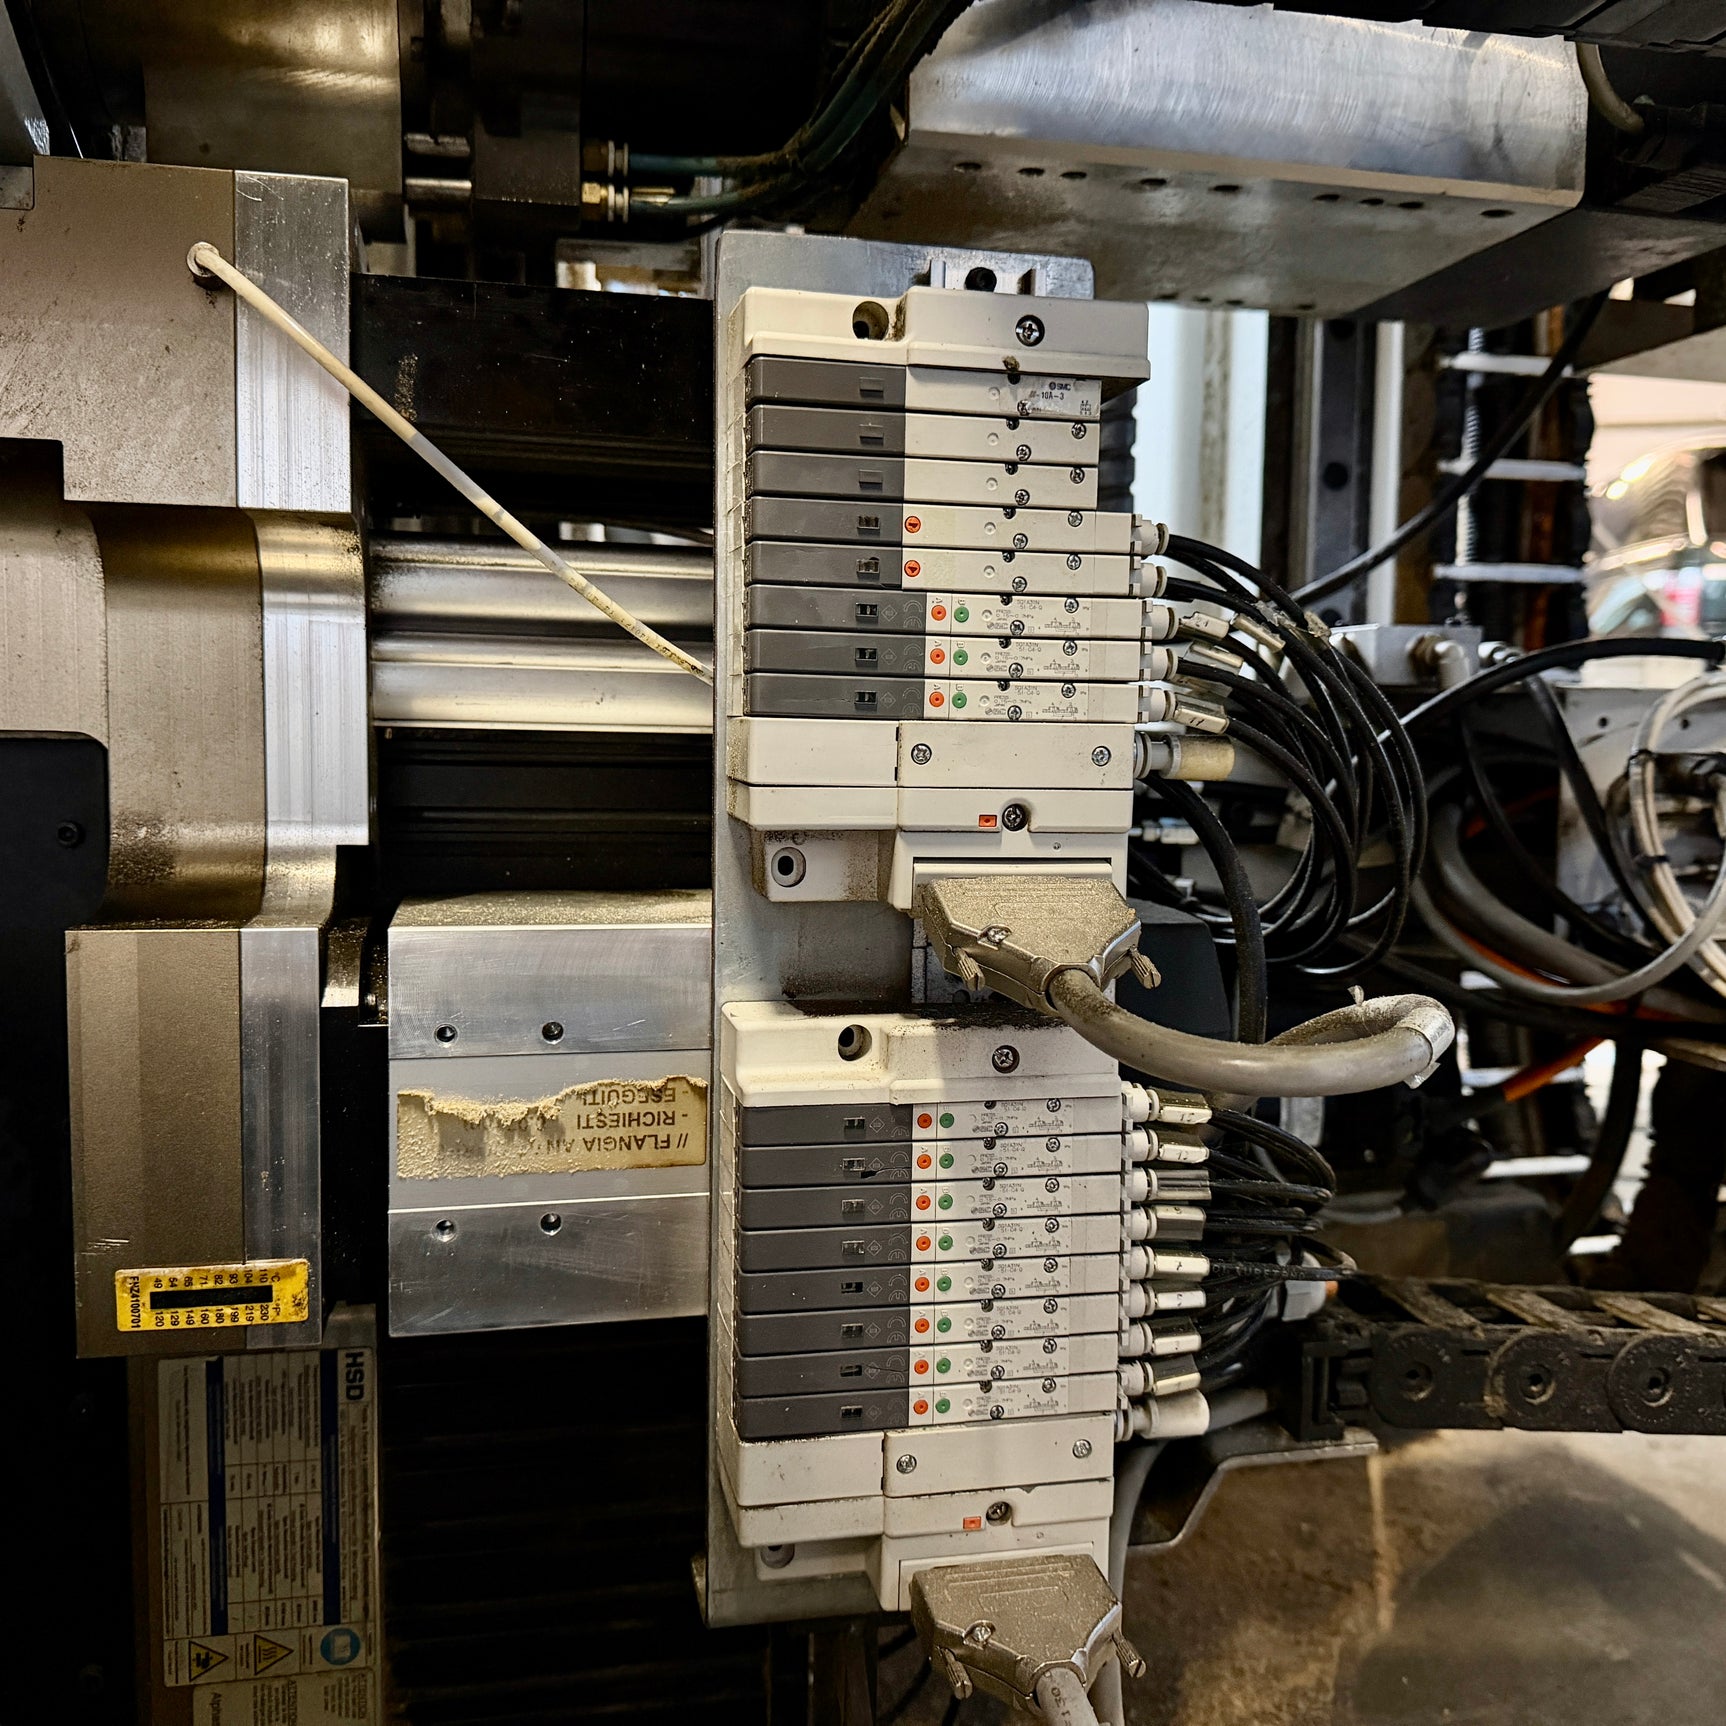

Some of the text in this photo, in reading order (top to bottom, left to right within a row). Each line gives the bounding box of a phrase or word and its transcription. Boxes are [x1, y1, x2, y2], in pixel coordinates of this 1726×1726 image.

[582, 1087, 676, 1106] ESEGUITI
[577, 1110, 676, 1129] RICHIESTI
[582, 1134, 671, 1152] FLANGIA
[154, 1278, 162, 1288] 49
[169, 1278, 177, 1287] 54
[184, 1277, 192, 1287] 65
[200, 1276, 208, 1285] 71
[215, 1275, 223, 1285] 82
[230, 1274, 238, 1284] 93
[245, 1269, 253, 1284] 104
[260, 1269, 268, 1282] 110
[155, 1312, 163, 1327] 120
[201, 1309, 209, 1324] 160
[246, 1305, 254, 1321] 219
[260, 1304, 268, 1320] 230
[345, 1352, 364, 1400] HSD
